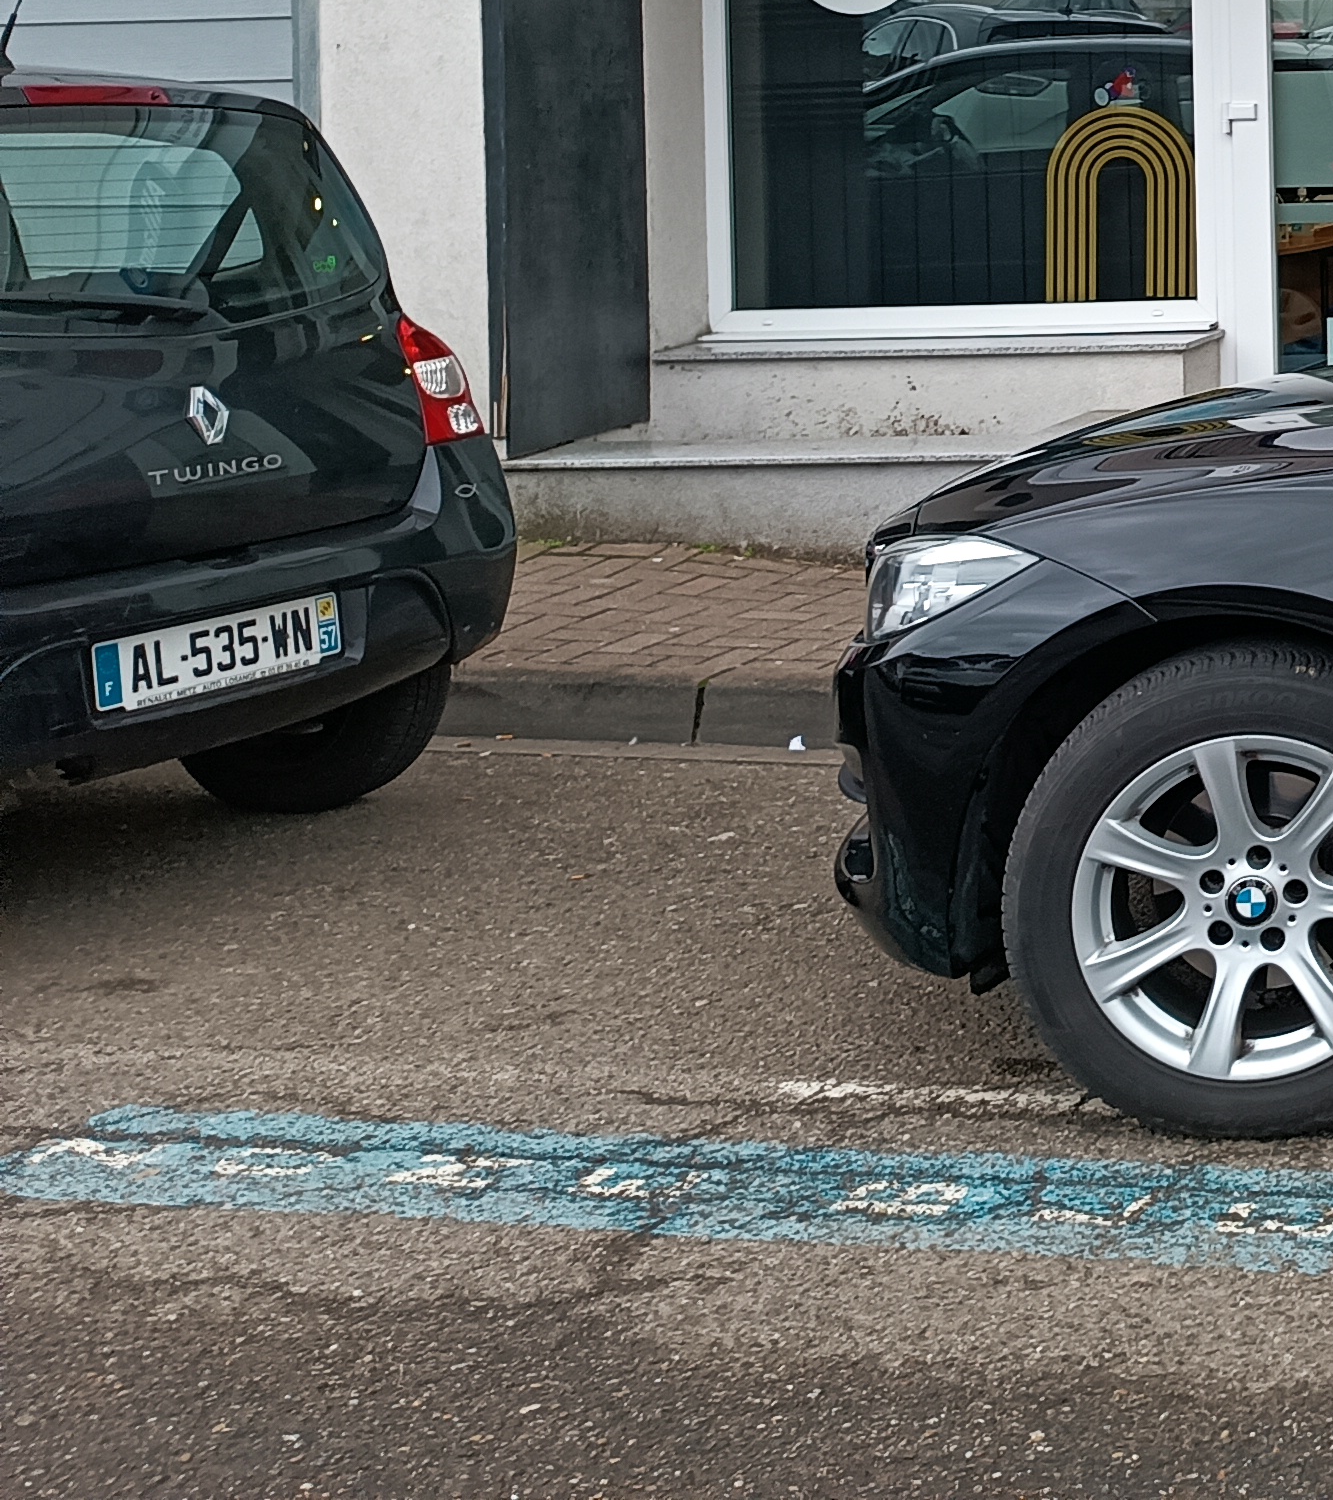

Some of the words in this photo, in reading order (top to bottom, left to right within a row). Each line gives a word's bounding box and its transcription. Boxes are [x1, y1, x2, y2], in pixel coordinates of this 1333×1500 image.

[147, 453, 282, 486] TWINGO
[104, 681, 114, 697] F
[131, 606, 313, 693] AL-535-WN
[319, 625, 337, 650] 57
